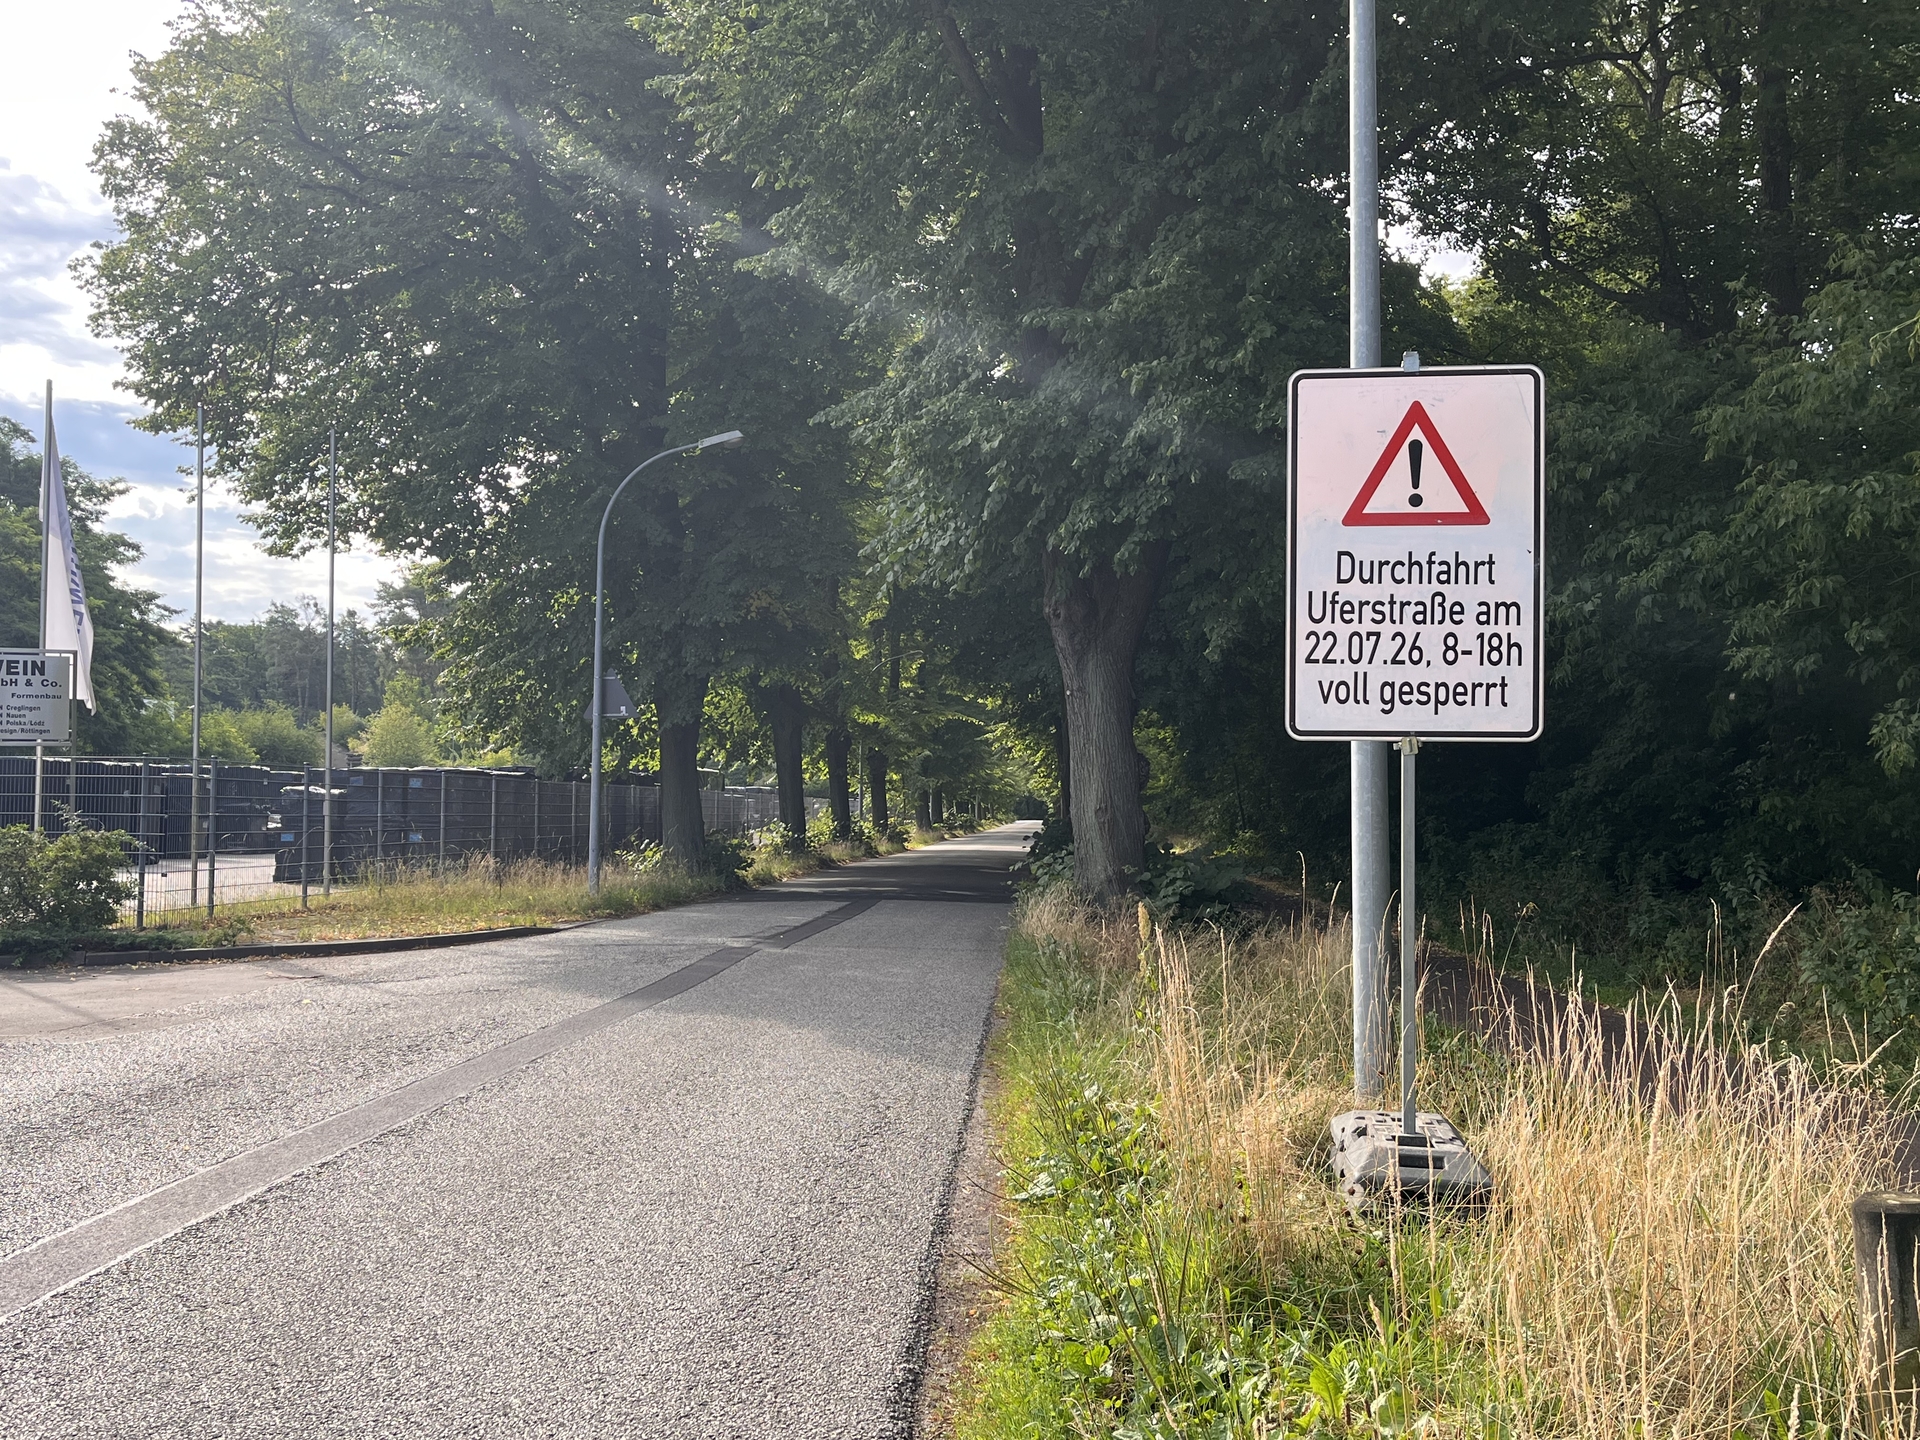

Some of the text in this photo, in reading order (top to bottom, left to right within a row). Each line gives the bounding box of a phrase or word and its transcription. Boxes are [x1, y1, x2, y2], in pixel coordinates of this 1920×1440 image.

[1336, 550, 1496, 585] Durchfahrt
[1307, 590, 1521, 626] Uferstraße am
[1304, 630, 1523, 669] 22.07.26, 8-18h
[24, 678, 33, 687] &
[41, 679, 62, 688] Co.
[1317, 671, 1509, 716] voll gesperrt
[11, 692, 62, 700] Formenbau
[6, 704, 41, 712] Creglingen
[0, 727, 51, 735] esign/Röttingen
